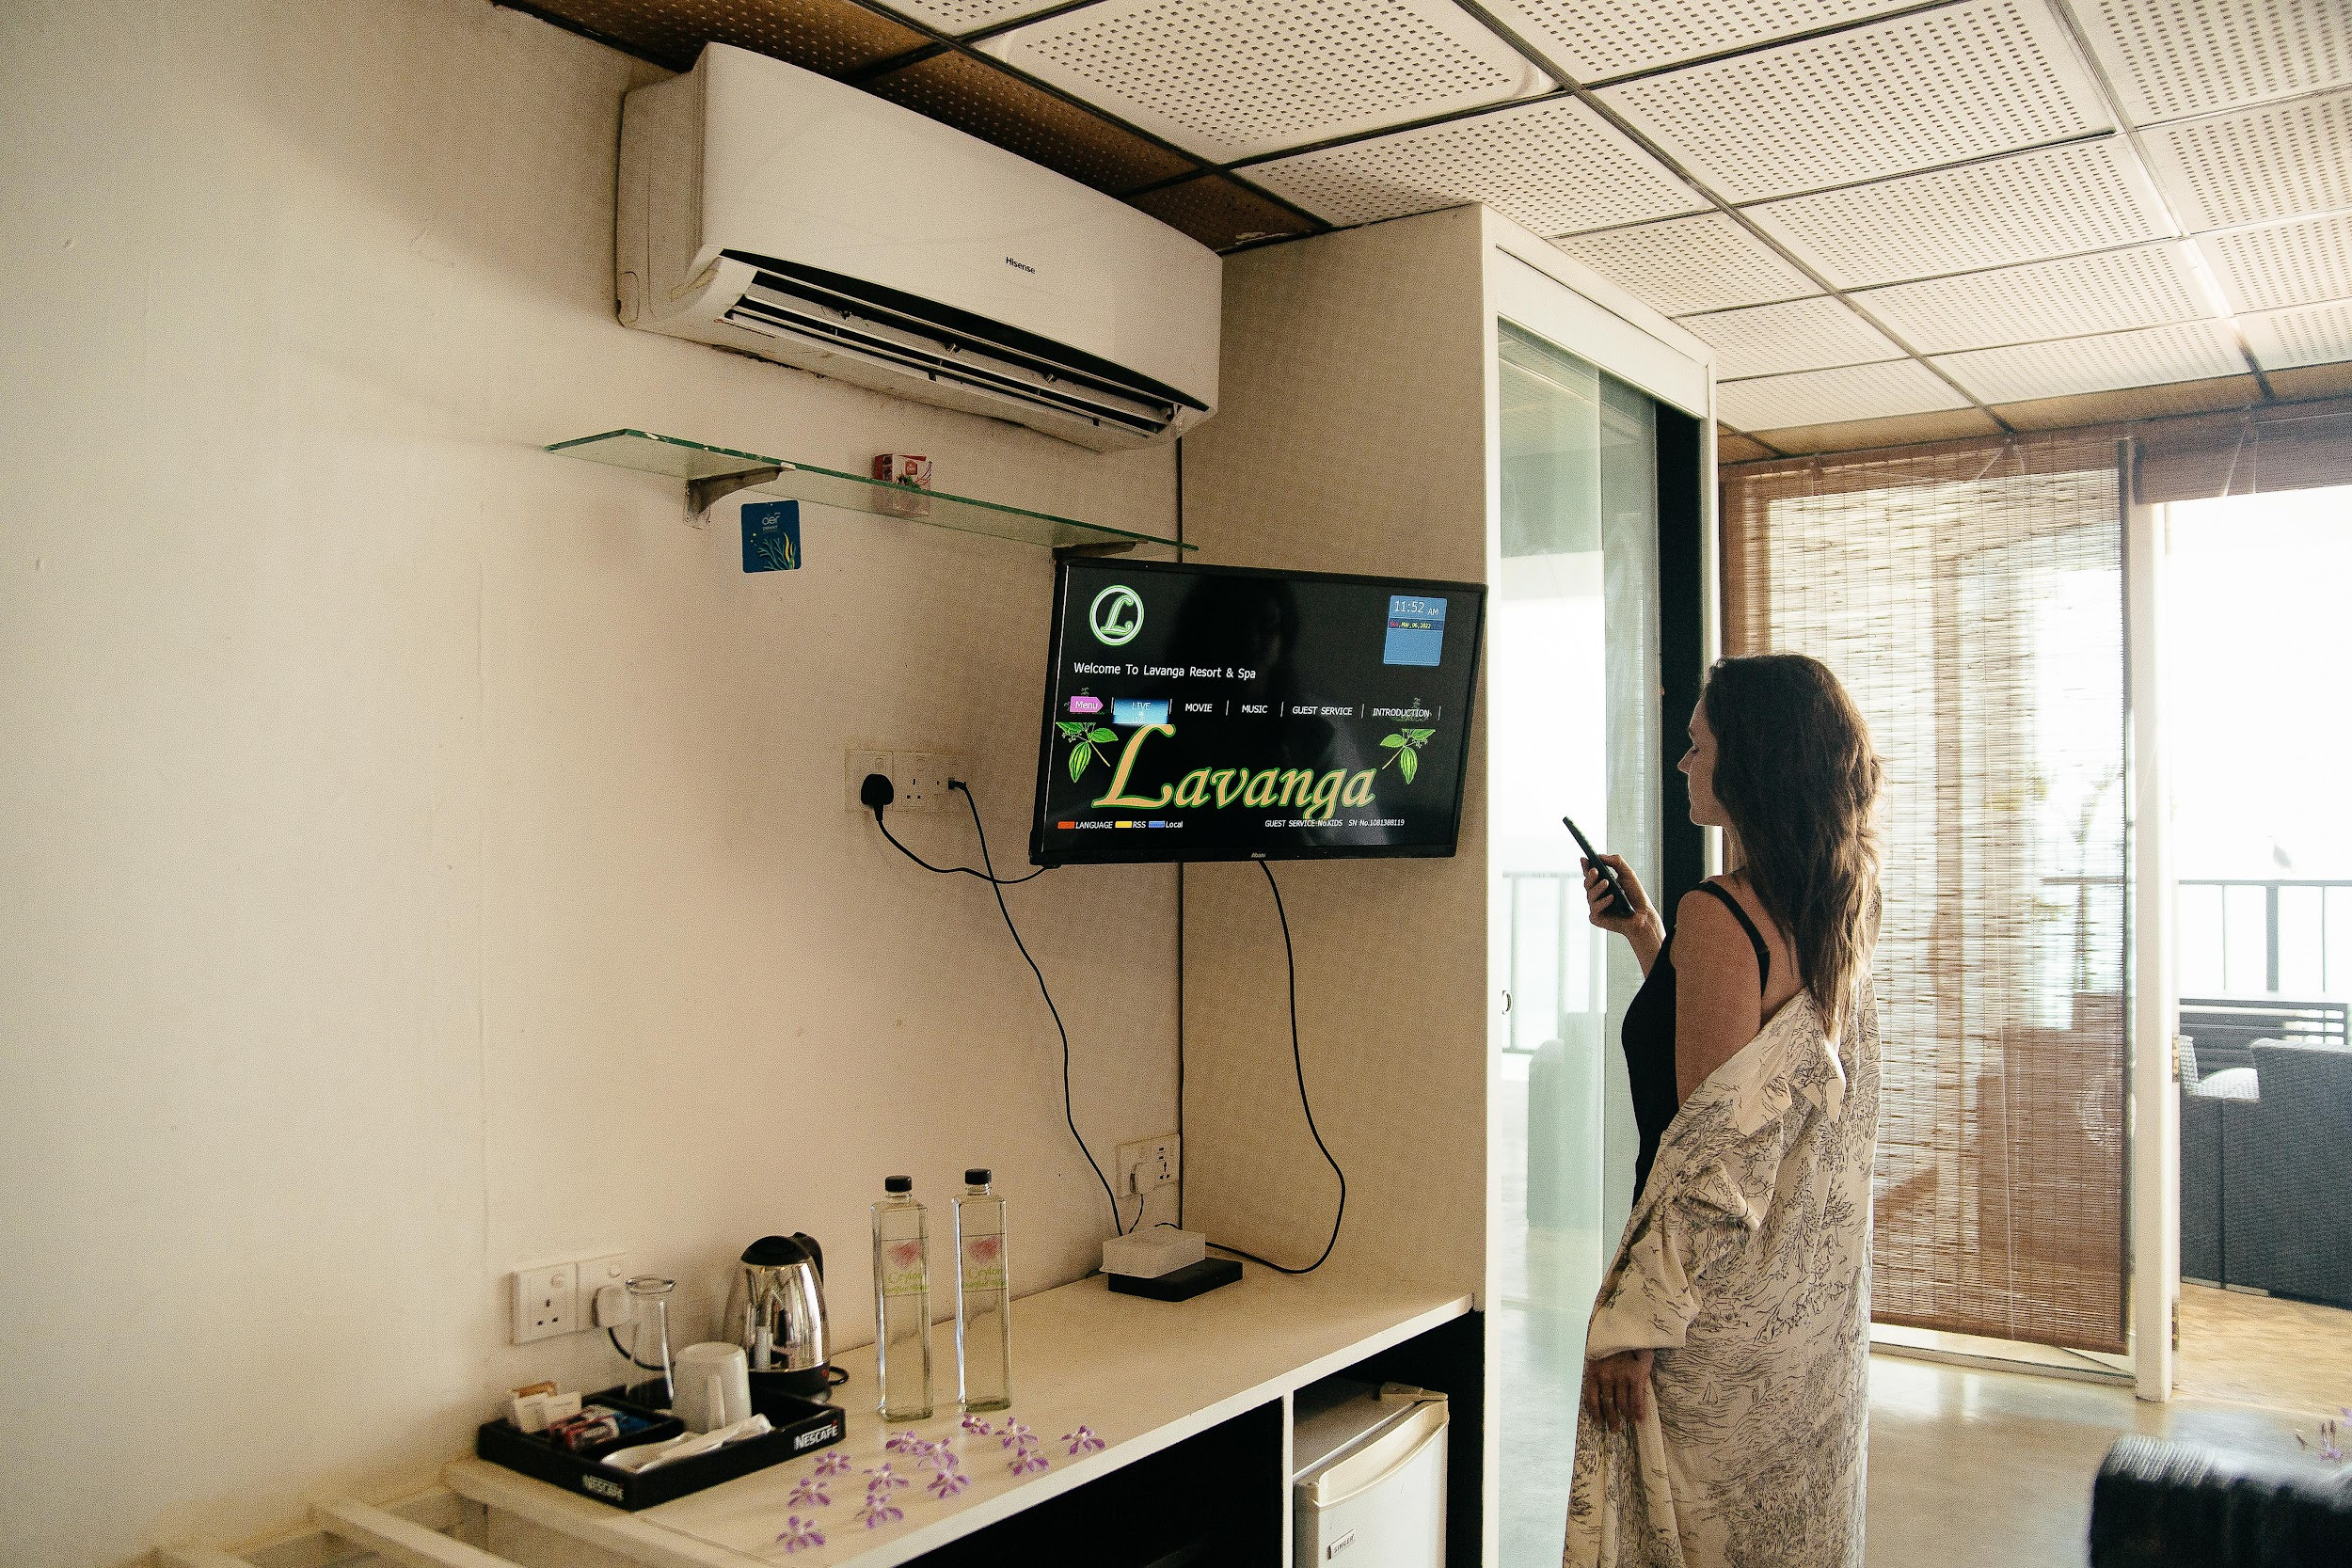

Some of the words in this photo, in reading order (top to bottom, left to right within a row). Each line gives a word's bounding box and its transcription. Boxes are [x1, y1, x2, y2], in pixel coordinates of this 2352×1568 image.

[1006, 256, 1036, 274] Hisense
[1394, 600, 1424, 613] 11:52
[1427, 608, 1439, 616] AM
[1073, 662, 1120, 674] Welcome
[1126, 664, 1138, 675] To
[1144, 665, 1184, 678] Lavanga
[1189, 666, 1221, 677] Resort
[1226, 668, 1233, 678] &
[1238, 668, 1256, 680] Spa
[1075, 700, 1099, 710] Menu
[1132, 702, 1152, 710] LIVE
[1184, 703, 1213, 712] MOVIE
[1242, 705, 1268, 714] MUSIC
[1292, 705, 1318, 715] GUEST
[1320, 706, 1353, 716] SERVICE
[1373, 707, 1430, 718] INTRODUCTION
[1091, 723, 1377, 821] Lavanga
[1264, 819, 1286, 828] GUEST
[1288, 819, 1315, 828] SERVICE
[1348, 818, 1358, 827] SN
[1333, 1534, 1354, 1554] SINGER
